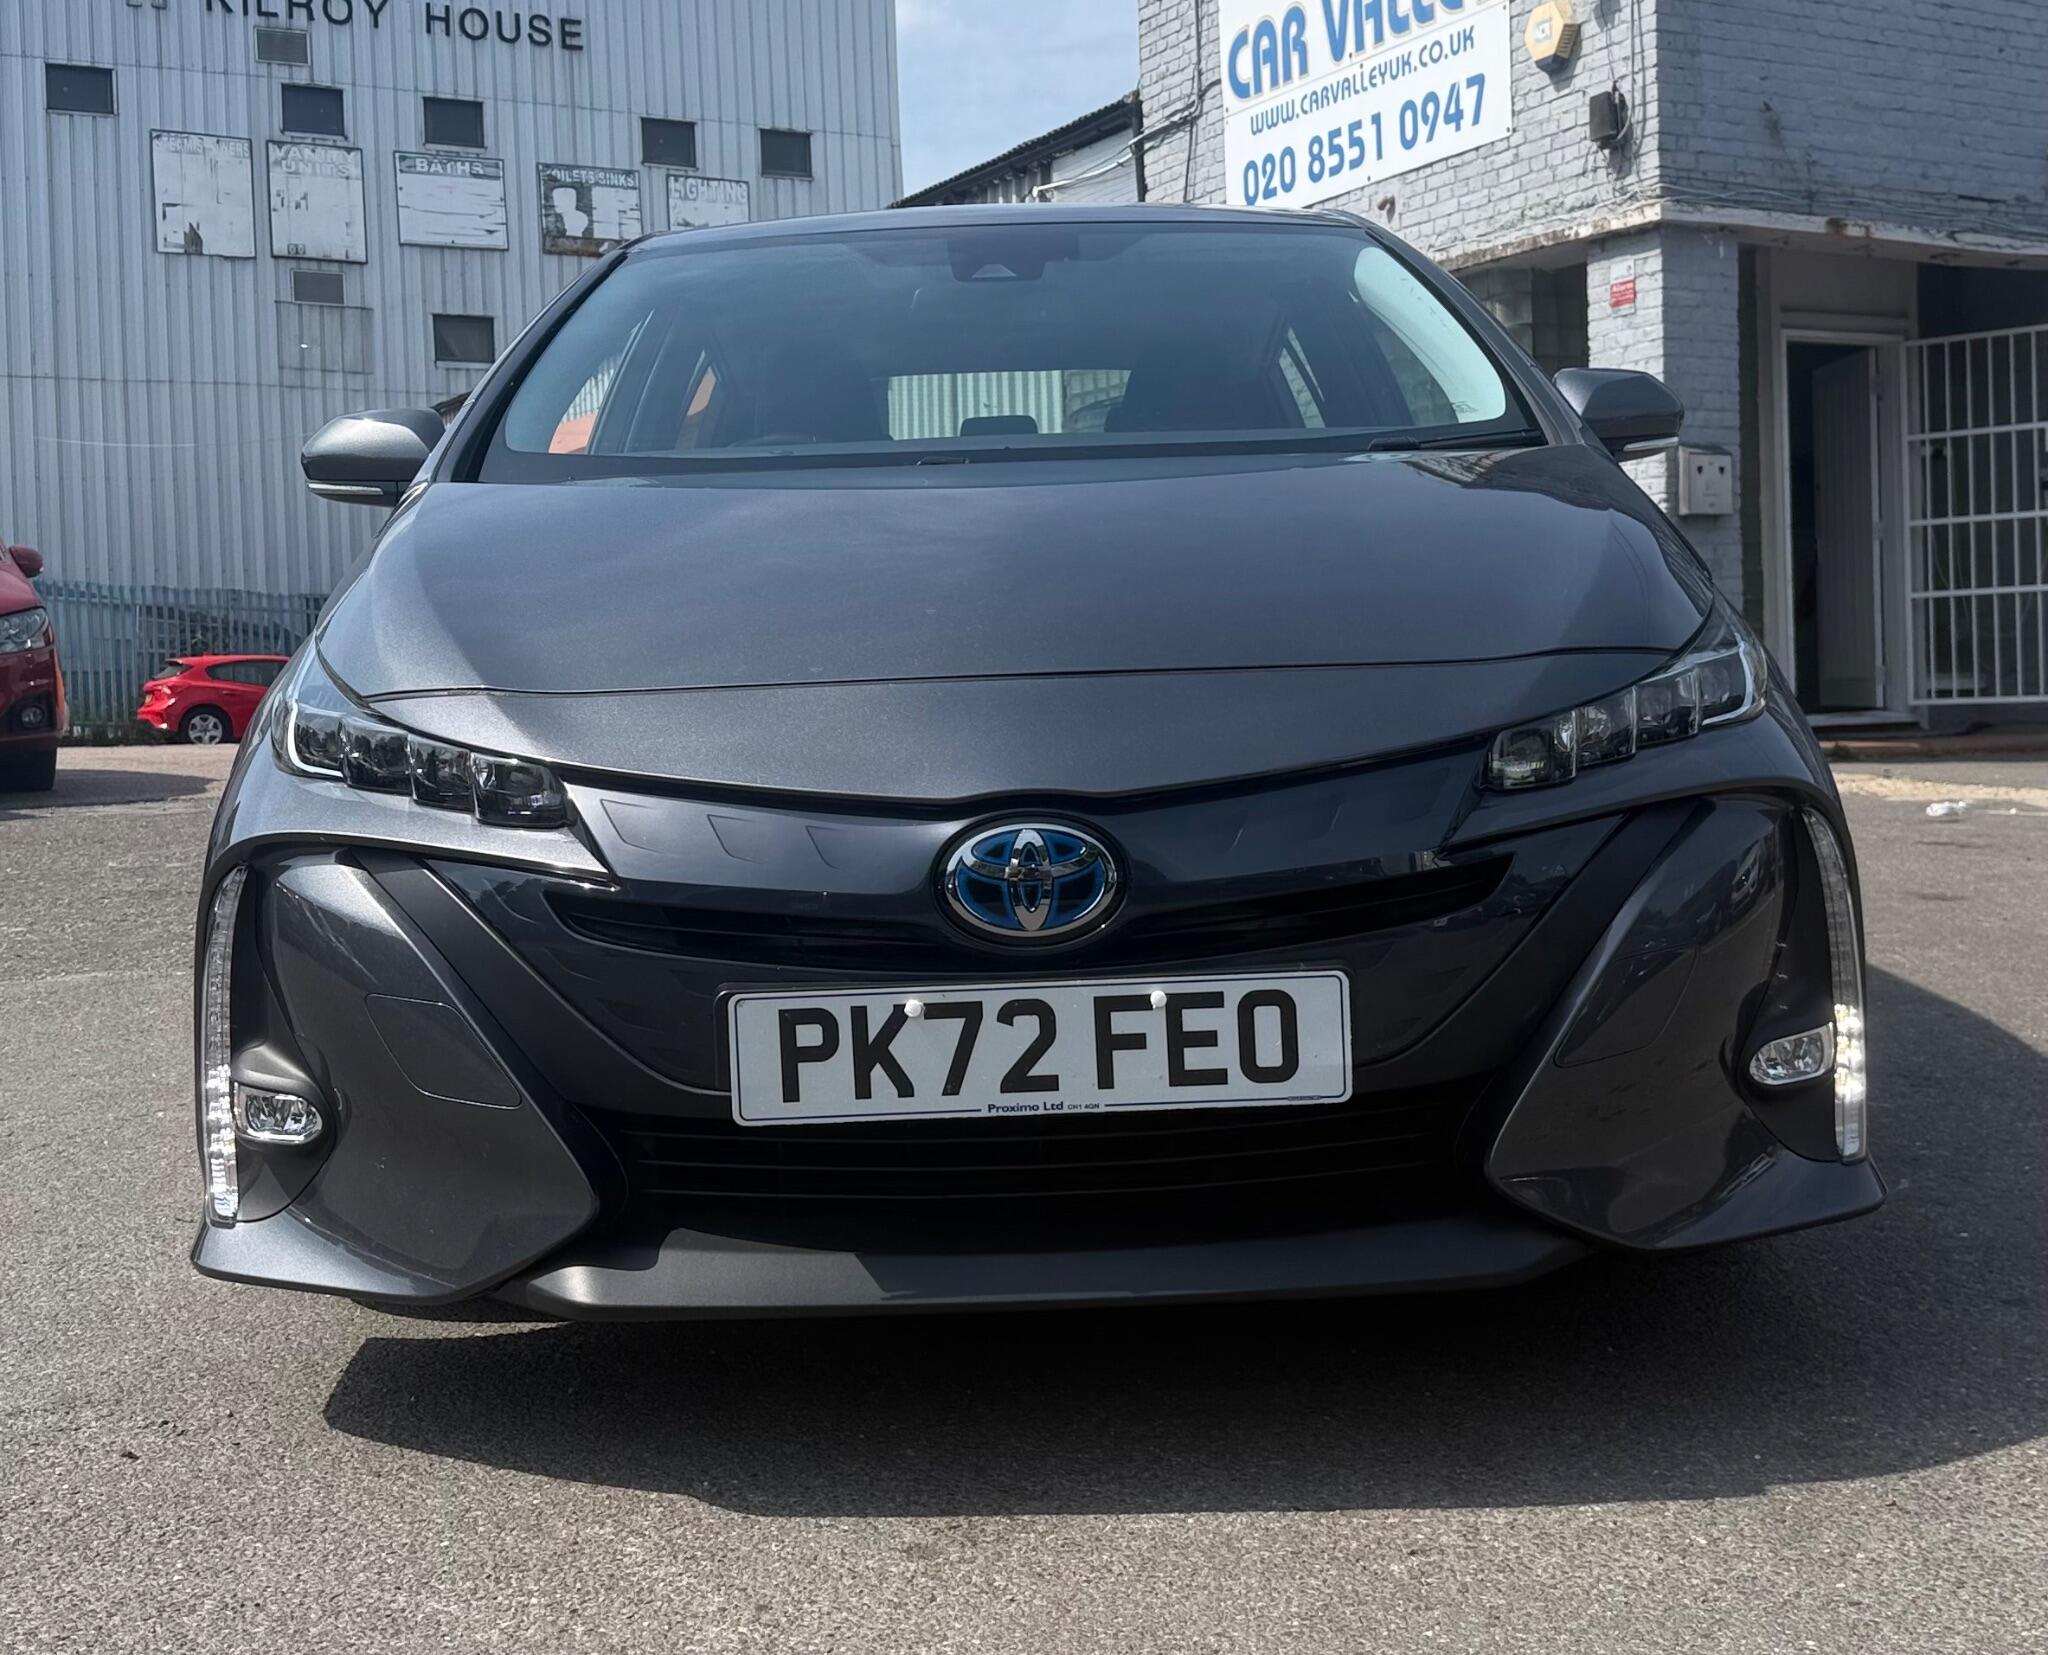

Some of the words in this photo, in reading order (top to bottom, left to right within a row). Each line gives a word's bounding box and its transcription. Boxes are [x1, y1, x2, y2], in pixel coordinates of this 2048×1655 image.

[425, 2, 584, 51] HOUSE
[1228, 5, 1309, 99] CAR
[1243, 146, 1296, 206] 020
[1308, 111, 1383, 184] 8551
[1399, 72, 1486, 150] 0947
[275, 144, 356, 162] VANITY
[281, 159, 350, 178] UNITS
[415, 157, 484, 176] BATHS
[598, 171, 635, 187] SINKS
[669, 176, 748, 203] LIGHTING
[778, 998, 1060, 1103] PK72
[1093, 988, 1300, 1091] FEO
[987, 1103, 1040, 1113] Proximo
[1043, 1100, 1064, 1112] Ltd
